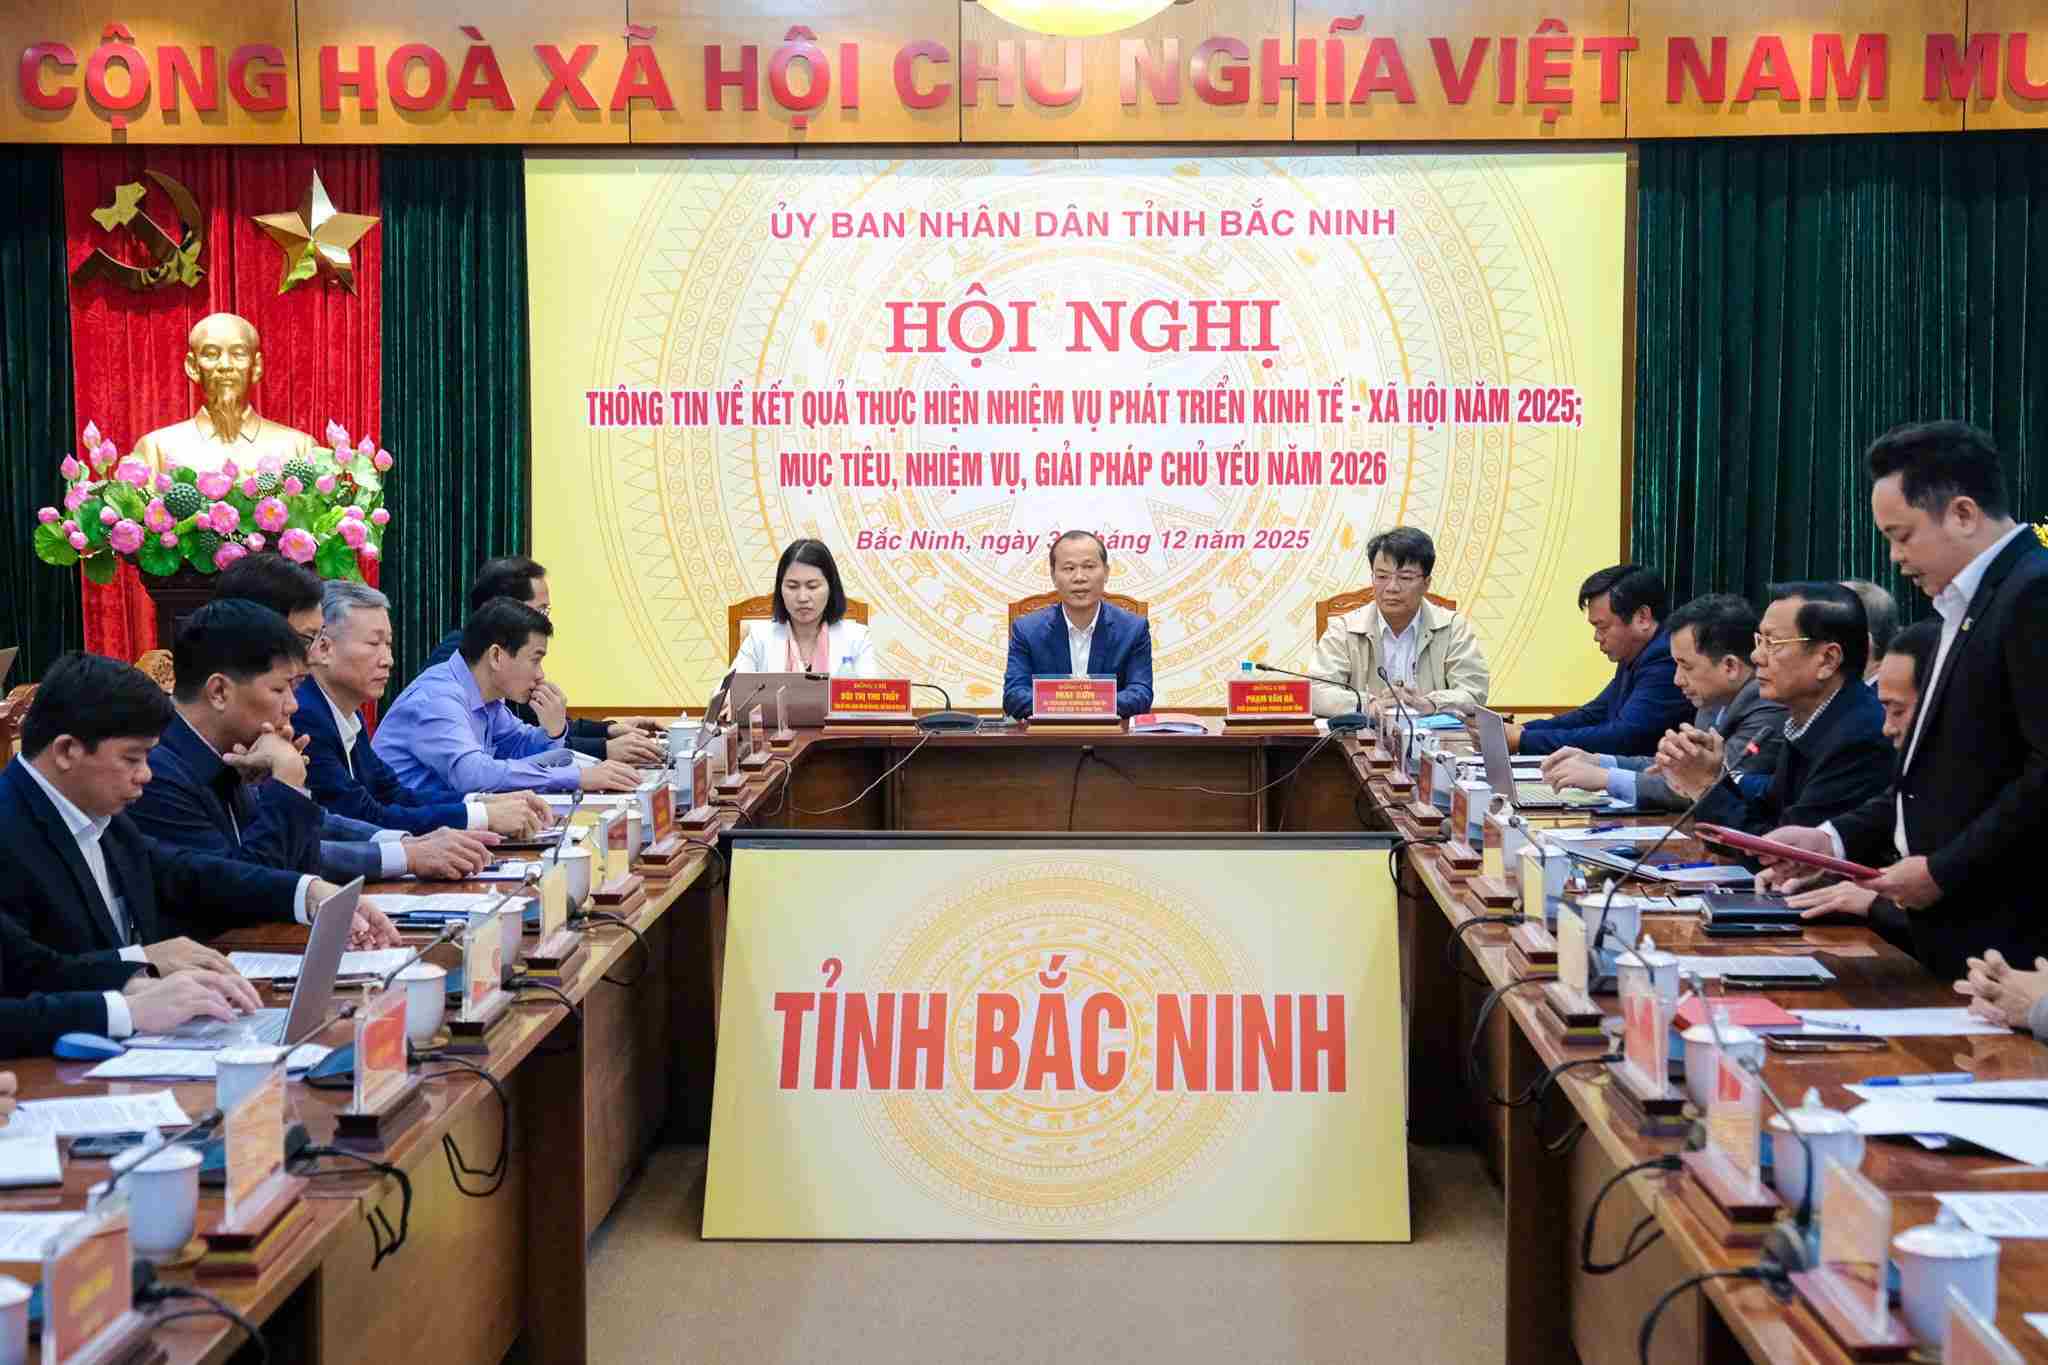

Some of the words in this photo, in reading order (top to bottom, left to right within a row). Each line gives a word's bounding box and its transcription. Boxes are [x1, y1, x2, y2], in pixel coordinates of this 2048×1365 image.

[19, 23, 289, 129] CỘNG
[318, 26, 516, 112] HOÀ
[532, 24, 675, 112] XÃ
[704, 25, 860, 129] HỘI
[1119, 15, 1417, 107] NGHĨA
[1428, 18, 1640, 124] VIỆT
[1667, 33, 1889, 103] NAM
[770, 202, 817, 239] ỦY
[831, 212, 905, 238] BAN
[919, 204, 1021, 238] NHÂN
[1035, 204, 1109, 237] DÂN
[1122, 199, 1206, 237] TỈNH
[1219, 197, 1295, 236] BẮC
[1308, 209, 1397, 236] NINH
[885, 282, 1037, 369] HỘI
[1065, 299, 1281, 369] NGHỊ
[586, 384, 663, 426] THÔNG
[670, 390, 708, 426] TIN
[715, 379, 745, 426] VỀ
[752, 380, 795, 426] KẾT
[802, 379, 849, 430] QUẢ
[856, 386, 917, 433] THỰC
[924, 383, 979, 433] HIỆN
[987, 383, 1065, 433] NHIỆM
[1073, 389, 1101, 432] VỤ
[1109, 382, 1171, 425] PHÁT
[1176, 375, 1246, 425] TRIỂN
[1253, 388, 1310, 425] KINH
[1317, 377, 1346, 425] TẾ
[1368, 382, 1400, 424] XÃ
[1407, 382, 1447, 431] HỘI
[1454, 380, 1510, 424] NĂM
[1517, 388, 1584, 429] 2025;
[780, 452, 833, 495] MỤC
[840, 446, 899, 491] TIÊU,
[906, 445, 984, 495] NHIỆM
[989, 452, 1028, 496] VỤ,
[1035, 440, 1082, 487] GIẢI
[1089, 444, 1153, 487] PHÁP
[1160, 439, 1208, 486] CHỦ
[1215, 439, 1260, 486] YẾU
[1267, 443, 1323, 486] NĂM
[1330, 451, 1388, 486] 2026
[856, 527, 902, 550] Bắc
[909, 530, 971, 553] Ninh,
[980, 530, 1040, 555] ngày
[1161, 530, 1187, 549] 12
[1194, 530, 1246, 549] năm
[1253, 529, 1310, 549] 2025
[774, 957, 949, 1091] TỈNH
[973, 954, 1128, 1092] BẮC
[1155, 993, 1347, 1093] NINH
